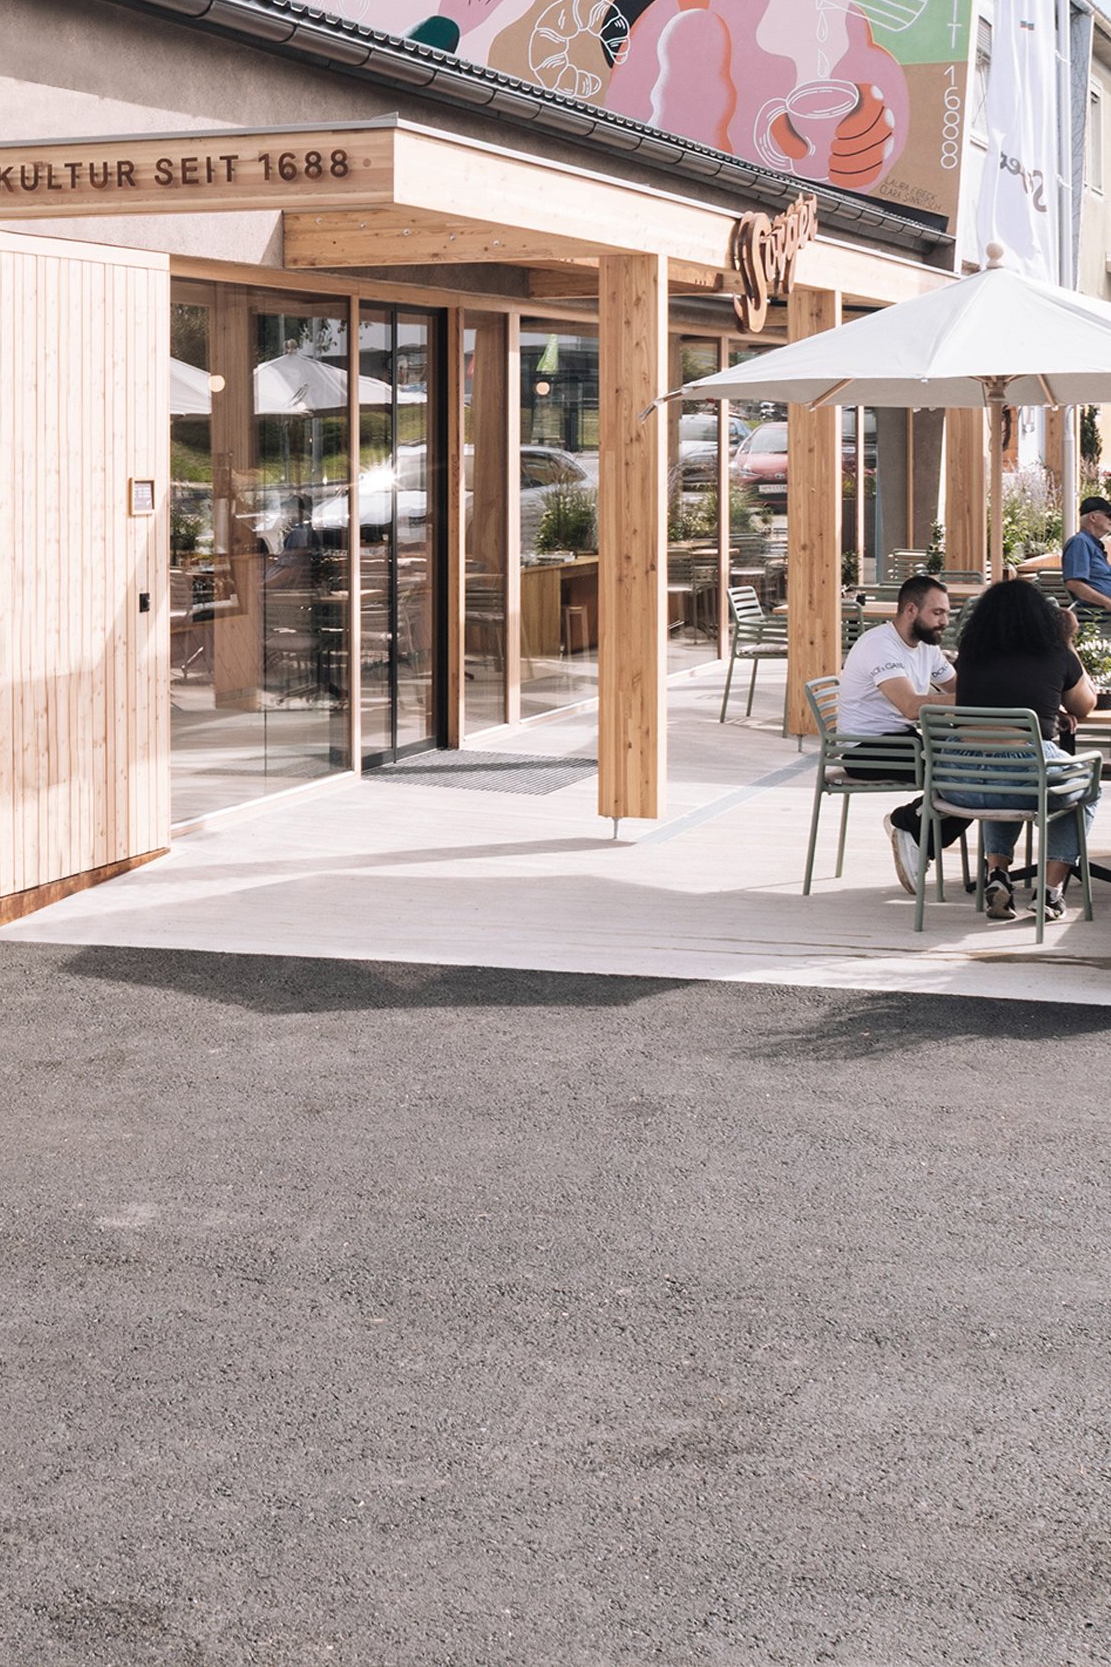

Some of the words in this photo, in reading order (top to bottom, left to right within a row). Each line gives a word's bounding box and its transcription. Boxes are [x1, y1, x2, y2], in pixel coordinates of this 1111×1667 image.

[940, 64, 961, 171] 1688
[154, 155, 239, 185] SEIT
[258, 149, 349, 182] 1688
